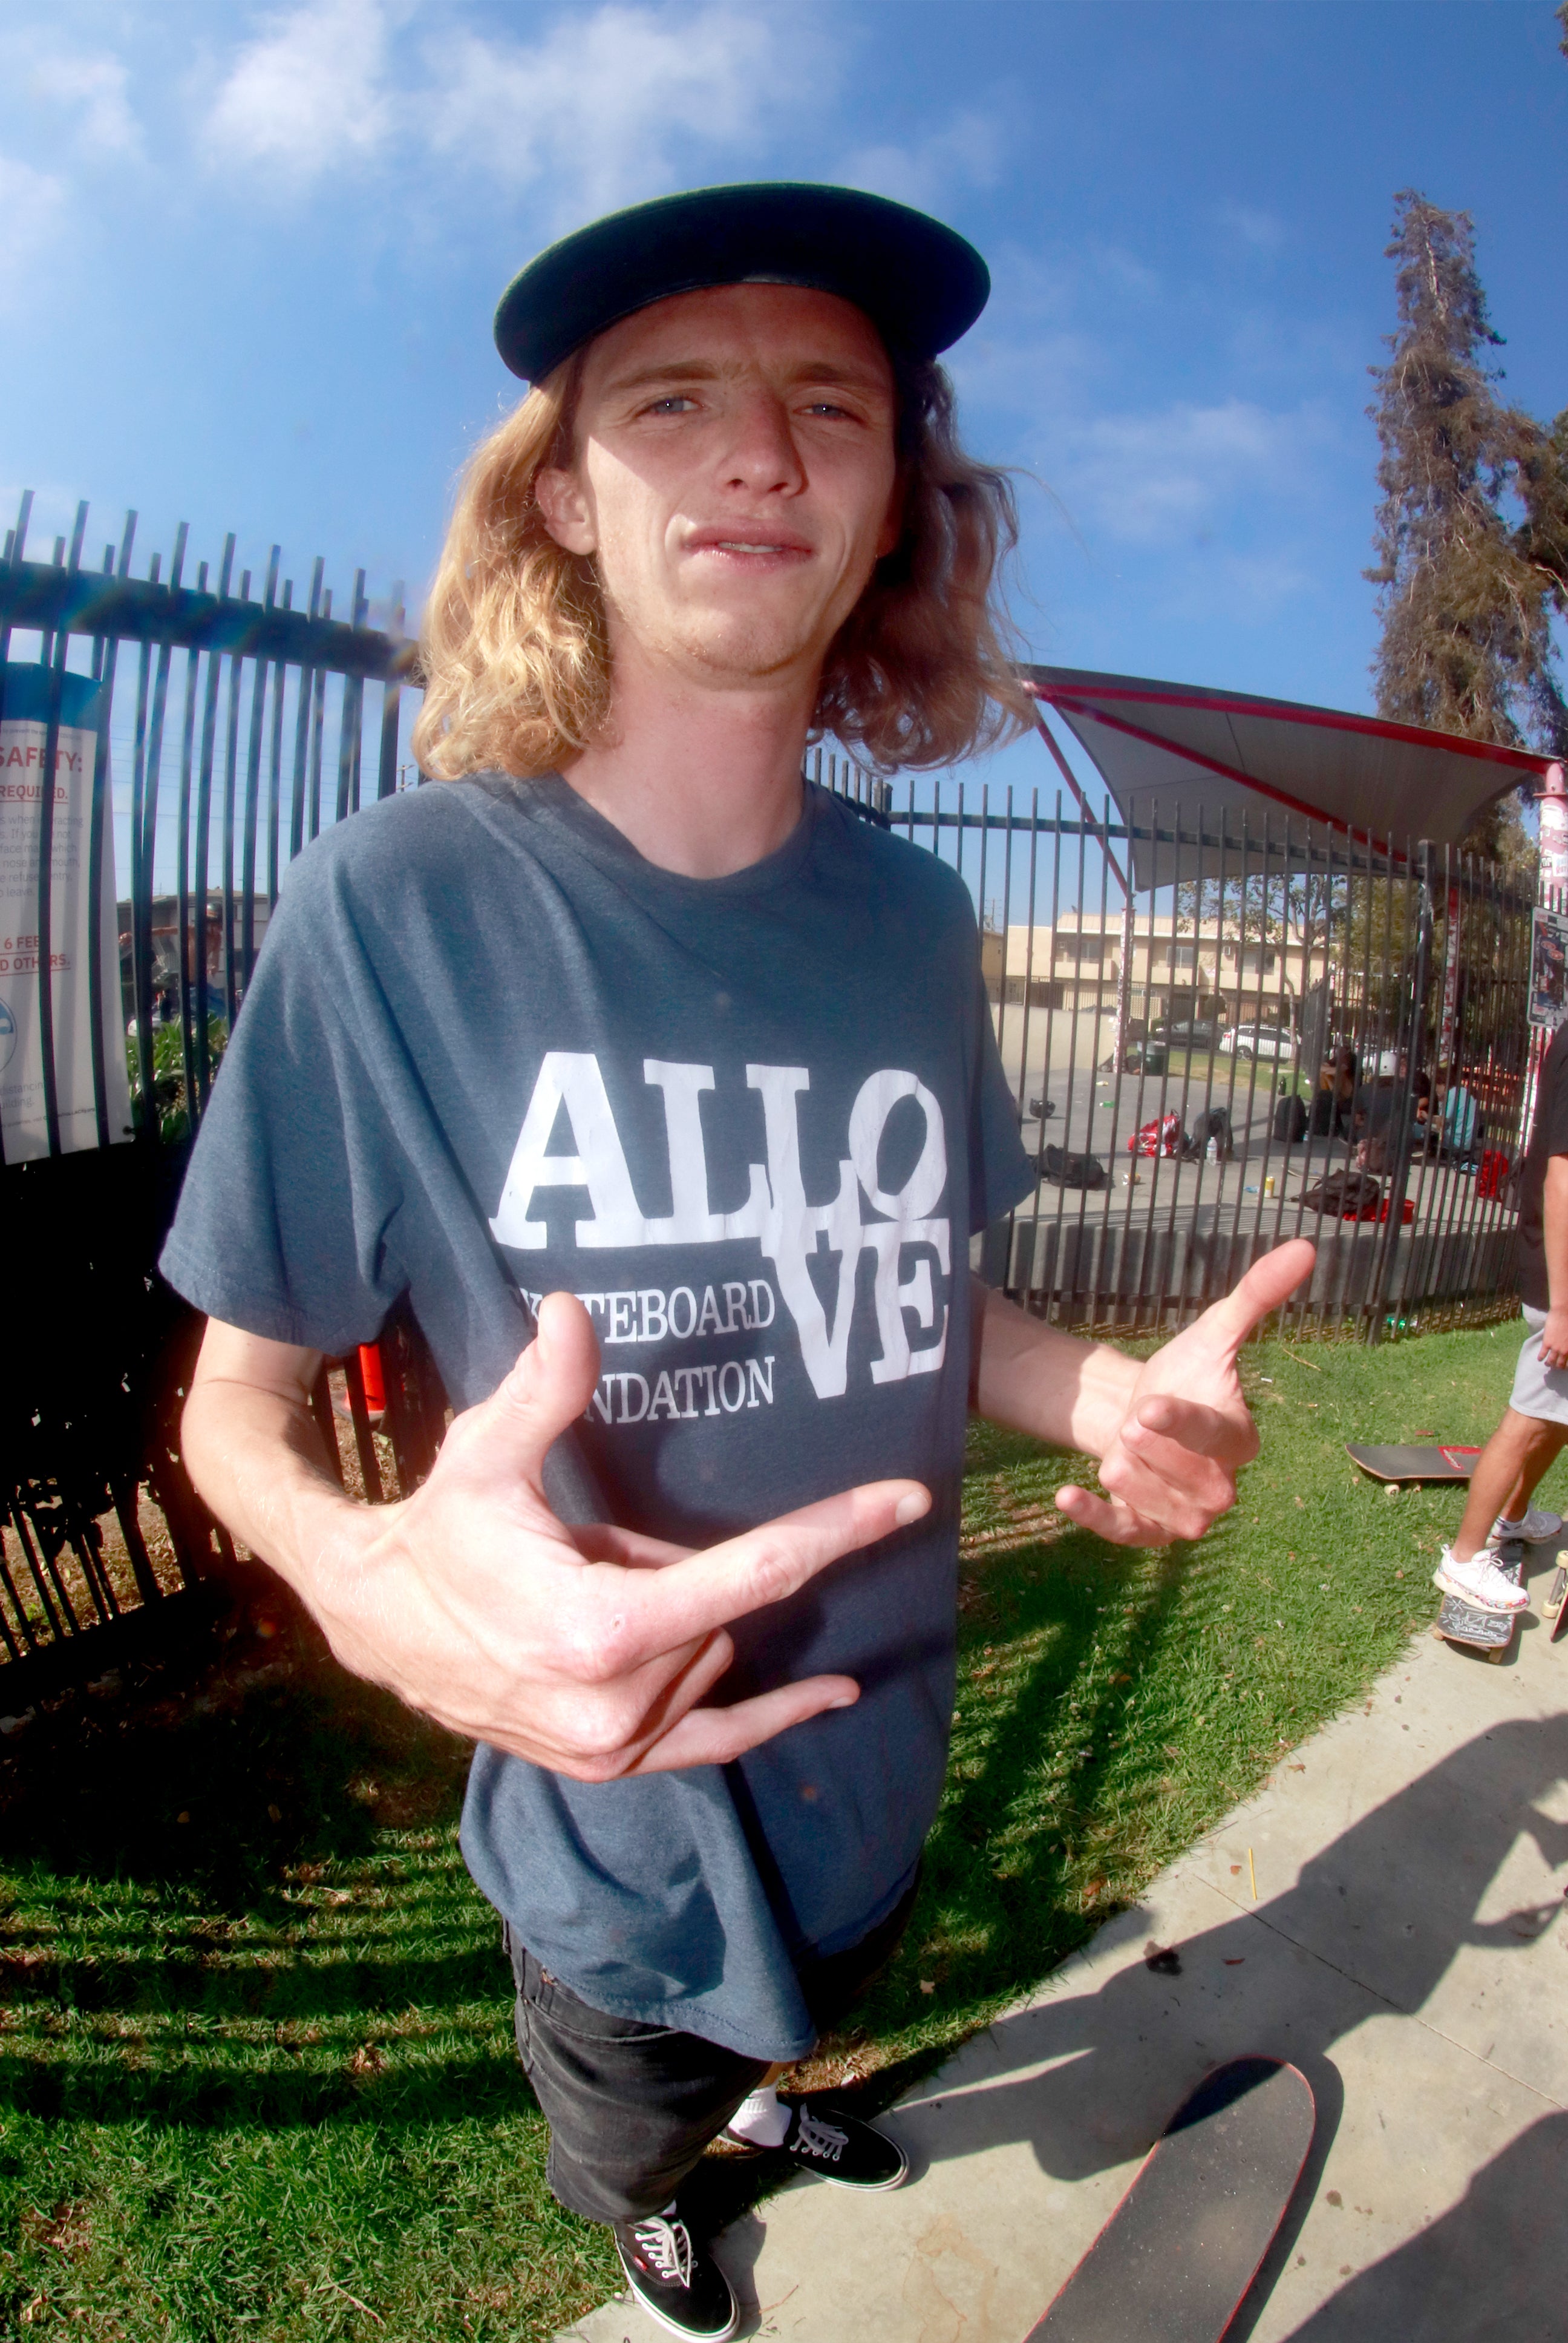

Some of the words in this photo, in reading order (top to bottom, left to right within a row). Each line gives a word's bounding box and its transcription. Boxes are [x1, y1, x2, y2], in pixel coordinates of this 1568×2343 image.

[0, 785, 68, 799] REQUID.
[4, 938, 12, 950] 6
[17, 936, 39, 949] FEE
[13, 954, 71, 970] OTHRS.
